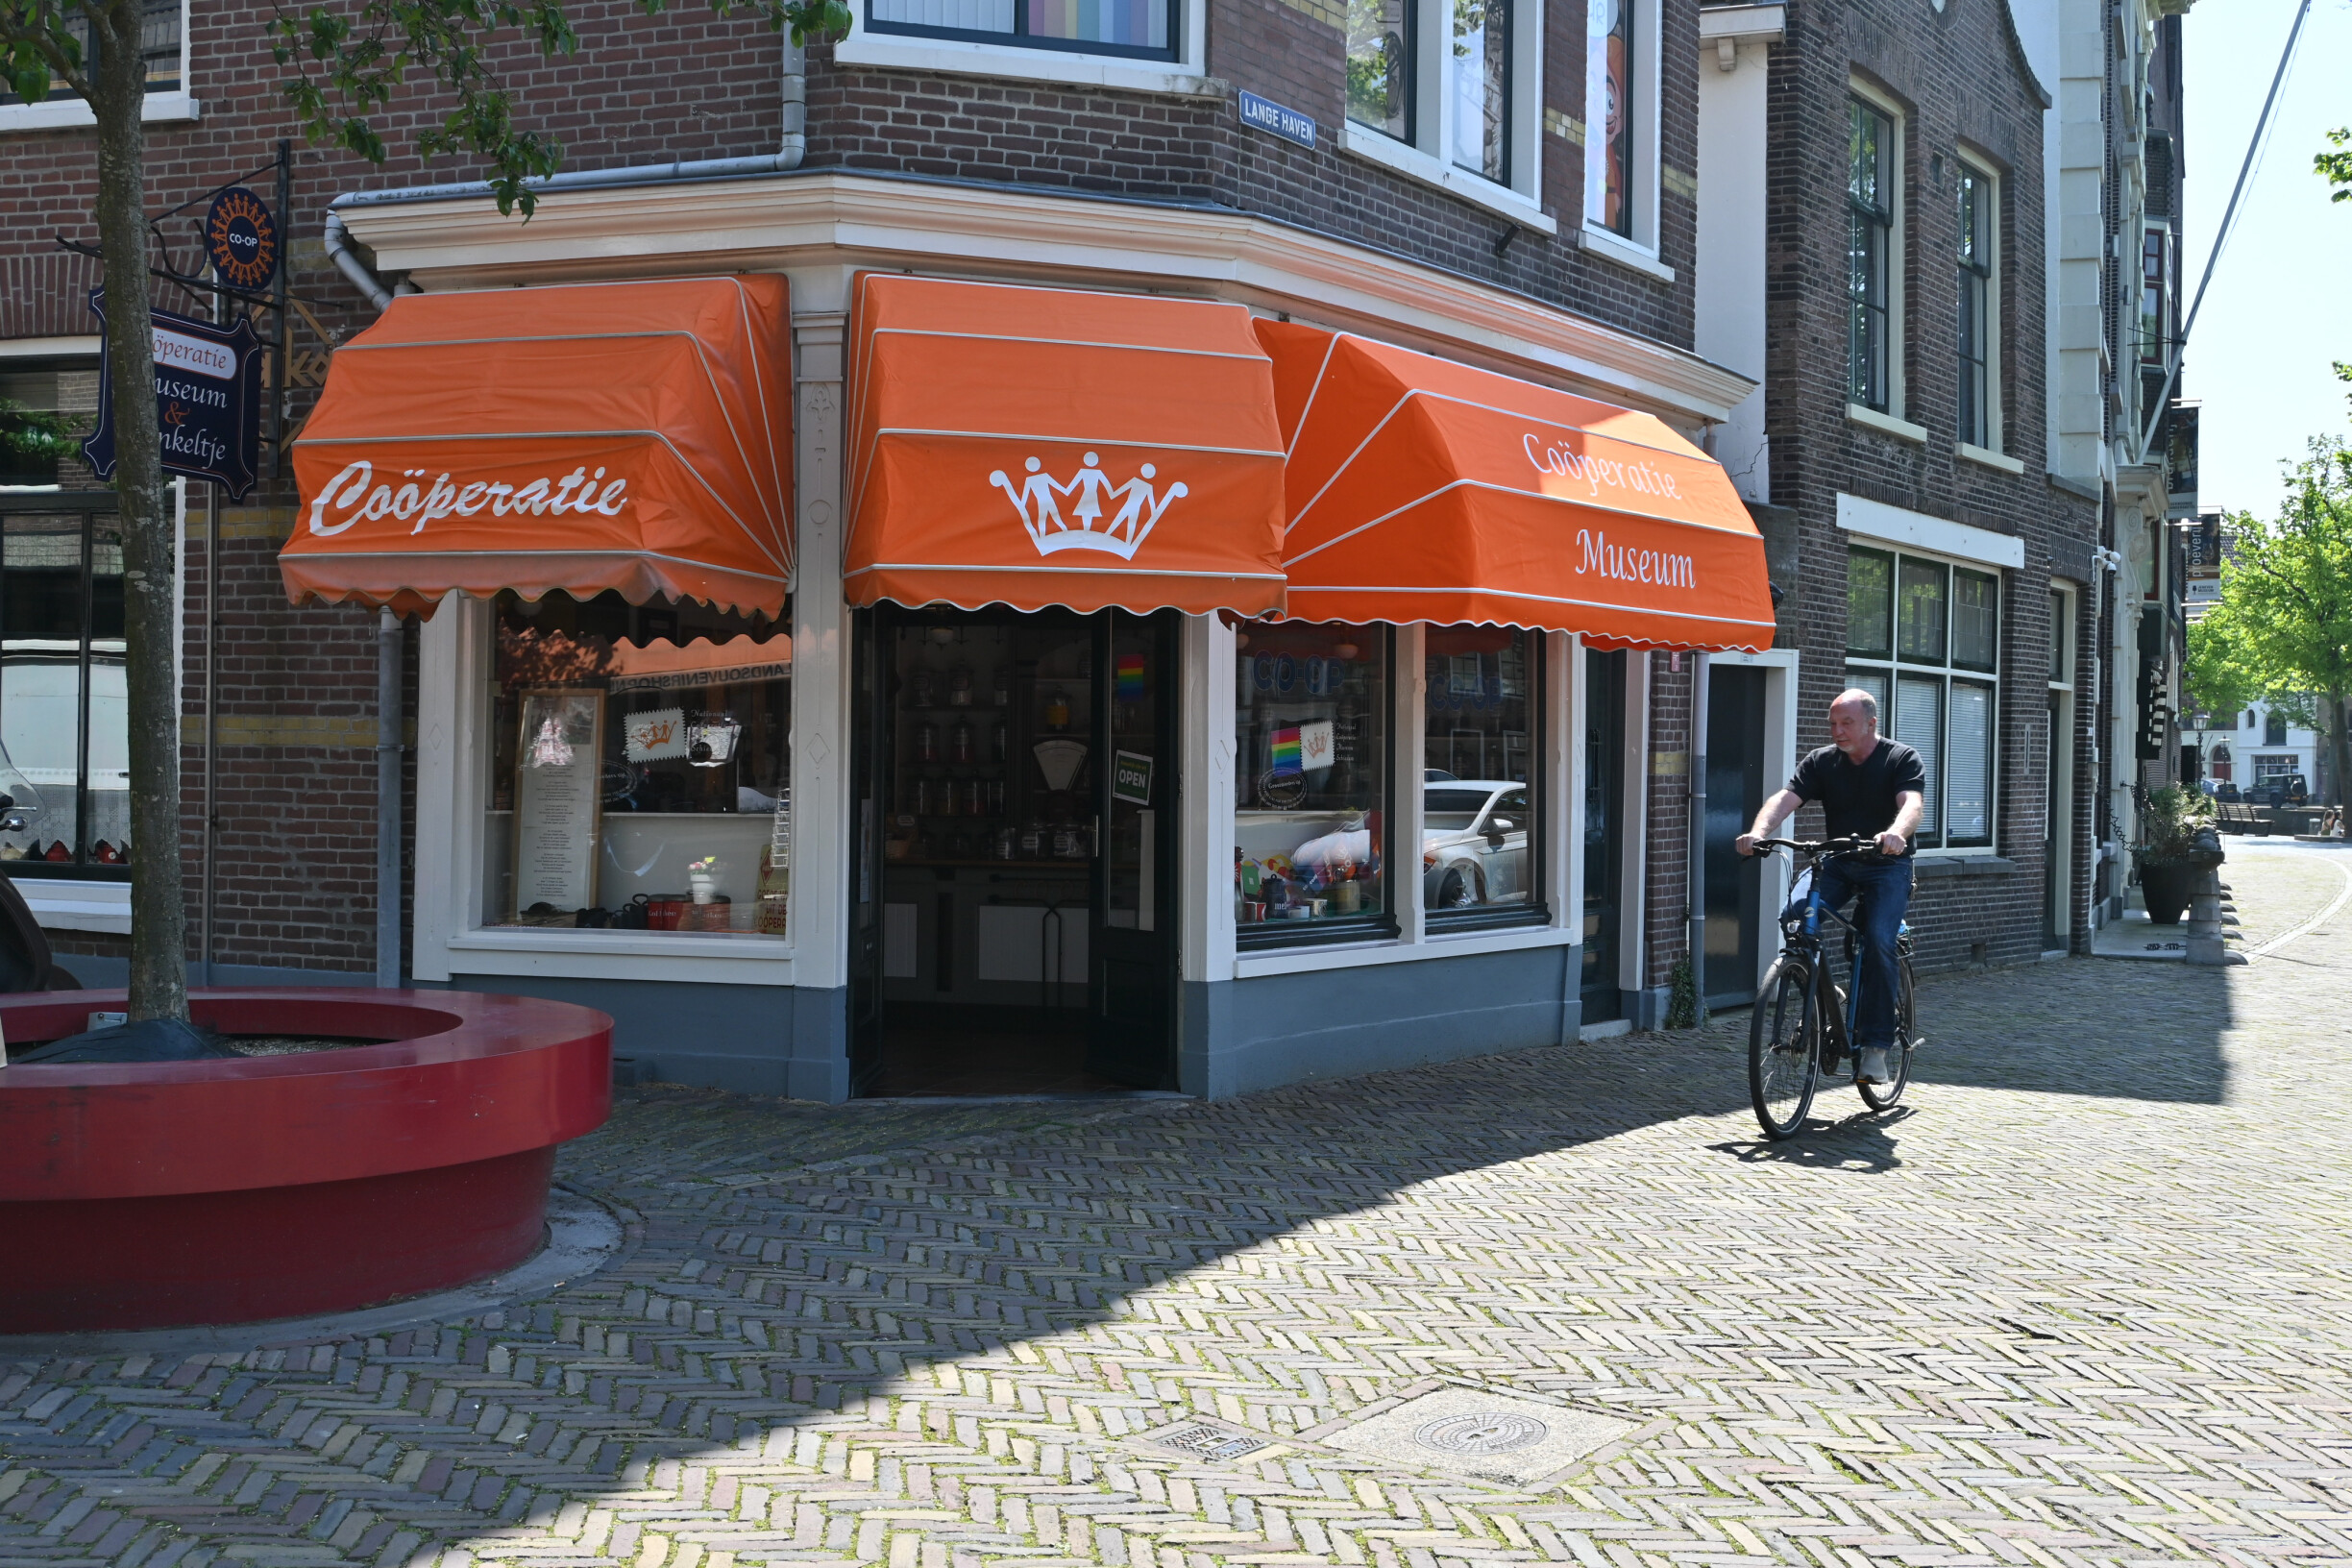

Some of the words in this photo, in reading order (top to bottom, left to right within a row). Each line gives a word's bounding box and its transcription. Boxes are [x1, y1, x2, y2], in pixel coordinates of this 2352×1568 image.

[1244, 98, 1279, 128] LANGE
[1281, 112, 1312, 142] HAVEN
[229, 233, 258, 248] CO-OP
[153, 334, 227, 369] öperatie
[154, 377, 228, 409] useum
[164, 402, 191, 426] &
[159, 424, 226, 470] nkeltje
[1523, 432, 1681, 501] Coöperatie
[309, 459, 627, 536] Coöperatie
[1575, 528, 1696, 589] Museum
[2192, 527, 2205, 577] proeverij
[1253, 649, 1345, 694] CO-OP
[1430, 674, 1503, 712] CO-OP
[1118, 769, 1146, 789] OPEN
